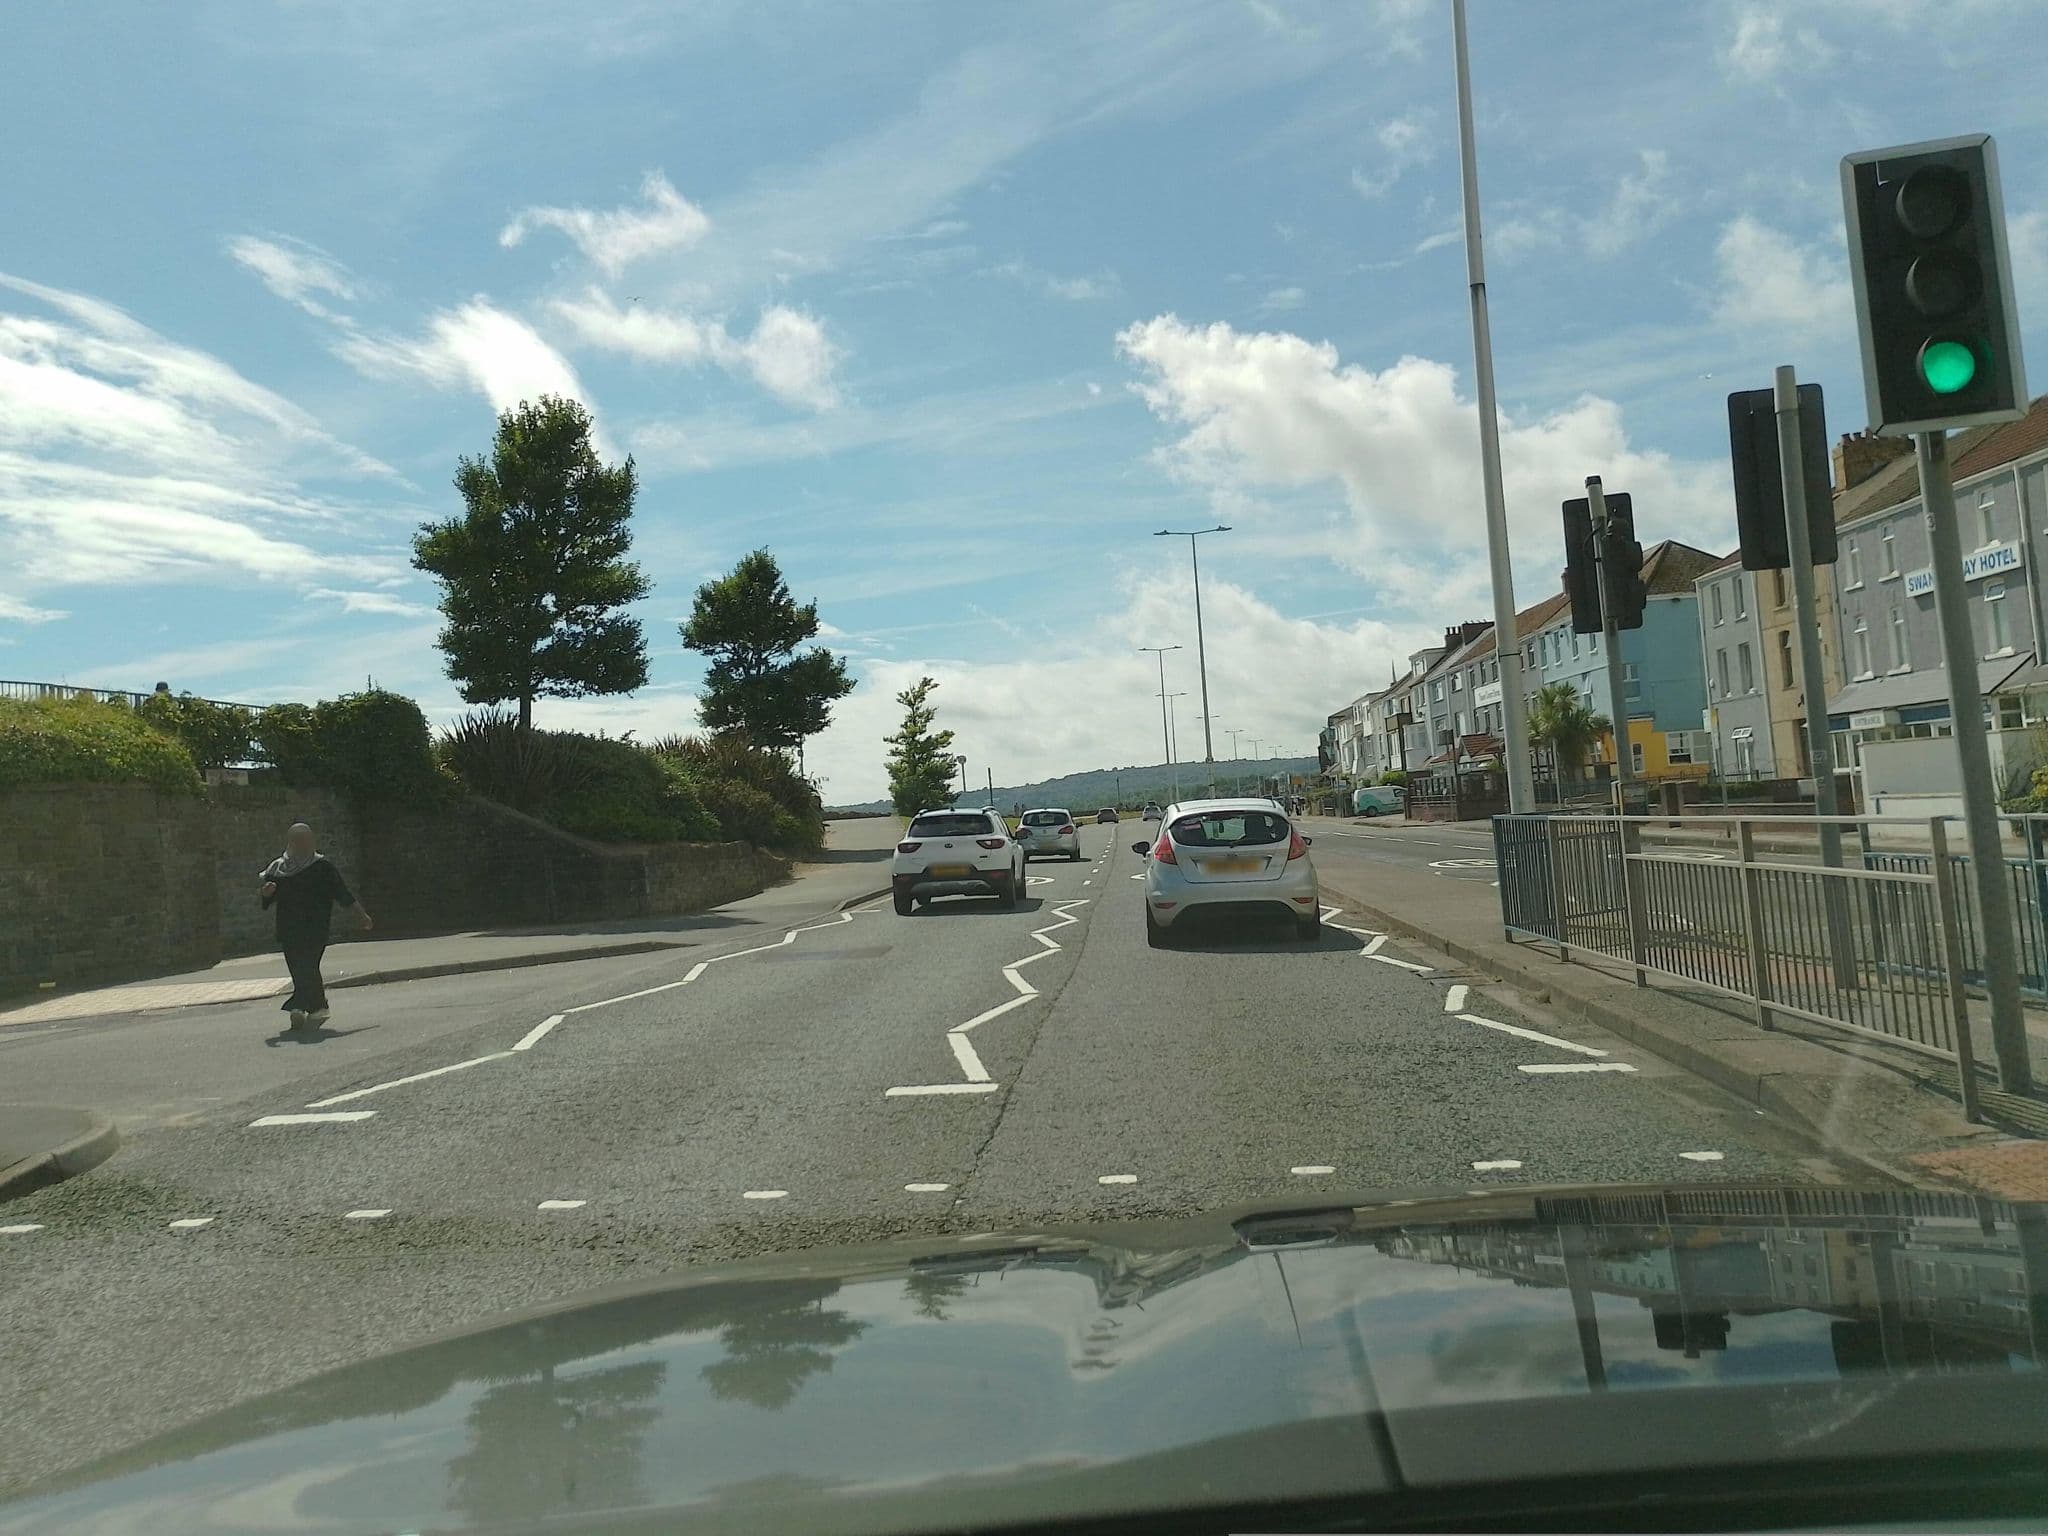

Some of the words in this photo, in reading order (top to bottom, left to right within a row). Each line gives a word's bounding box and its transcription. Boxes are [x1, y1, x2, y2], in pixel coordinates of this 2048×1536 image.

[1908, 572, 1934, 592] SWAN
[1962, 558, 1976, 577] AY
[1979, 547, 2017, 572] HOTEL
